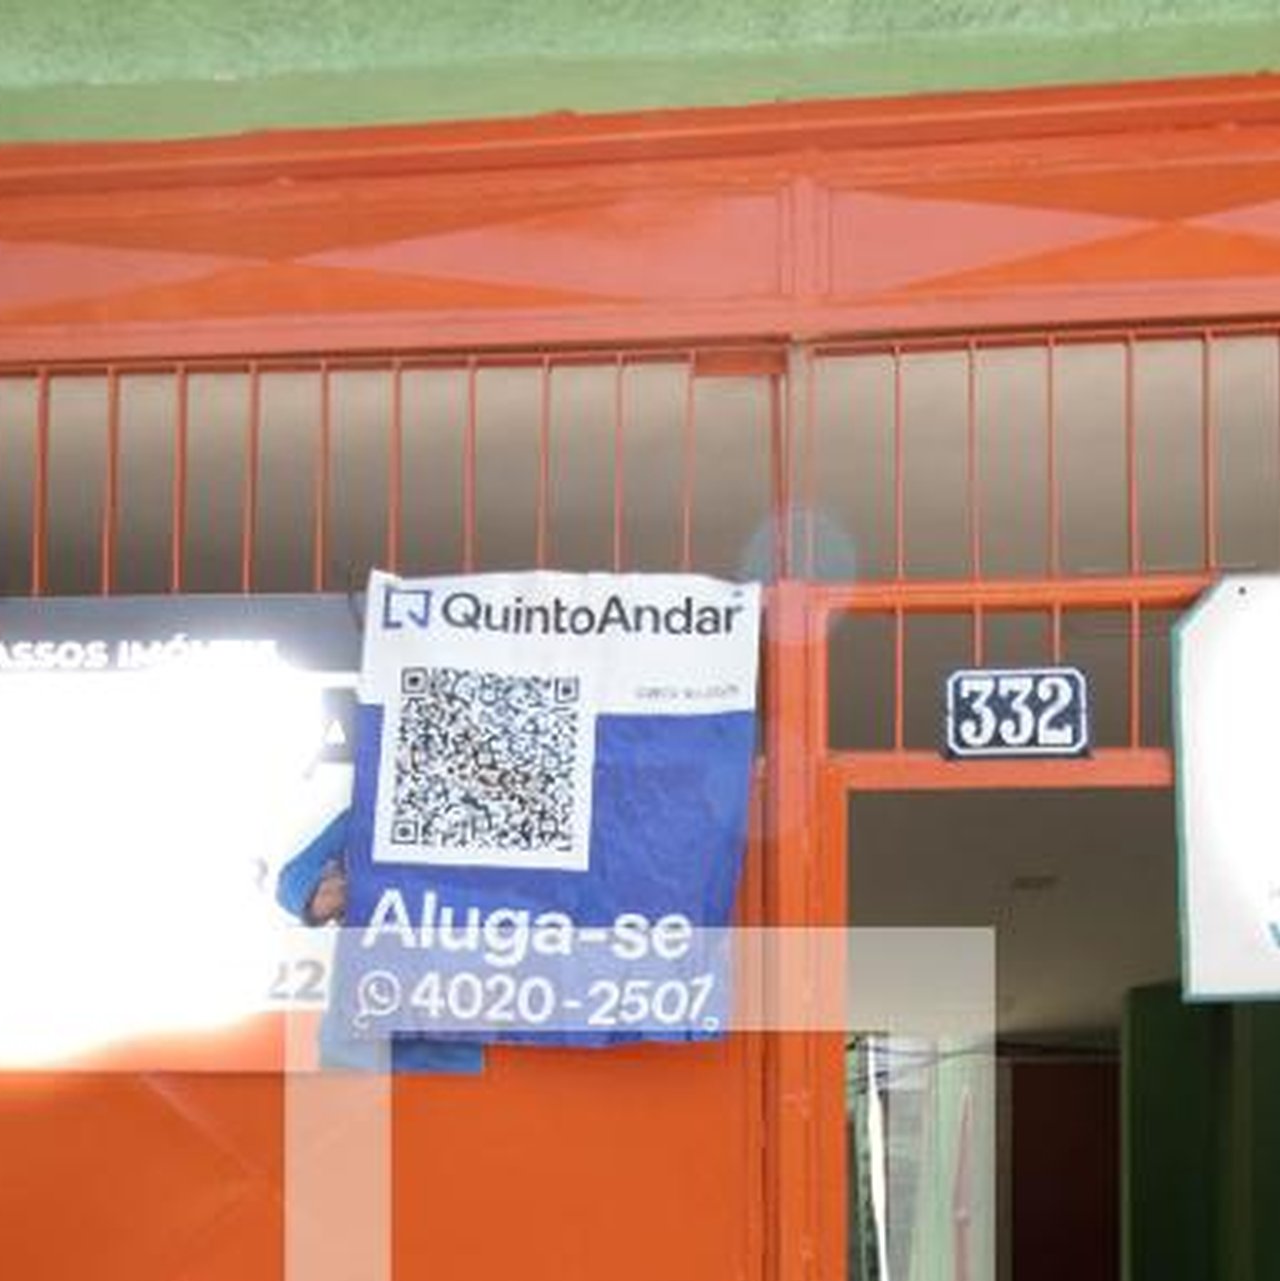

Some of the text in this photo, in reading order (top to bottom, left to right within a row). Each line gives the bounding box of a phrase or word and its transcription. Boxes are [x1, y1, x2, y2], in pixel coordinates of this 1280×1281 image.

[441, 591, 744, 635] QuintoAndar
[959, 676, 1073, 747] 332
[362, 888, 694, 967] Aluga-se
